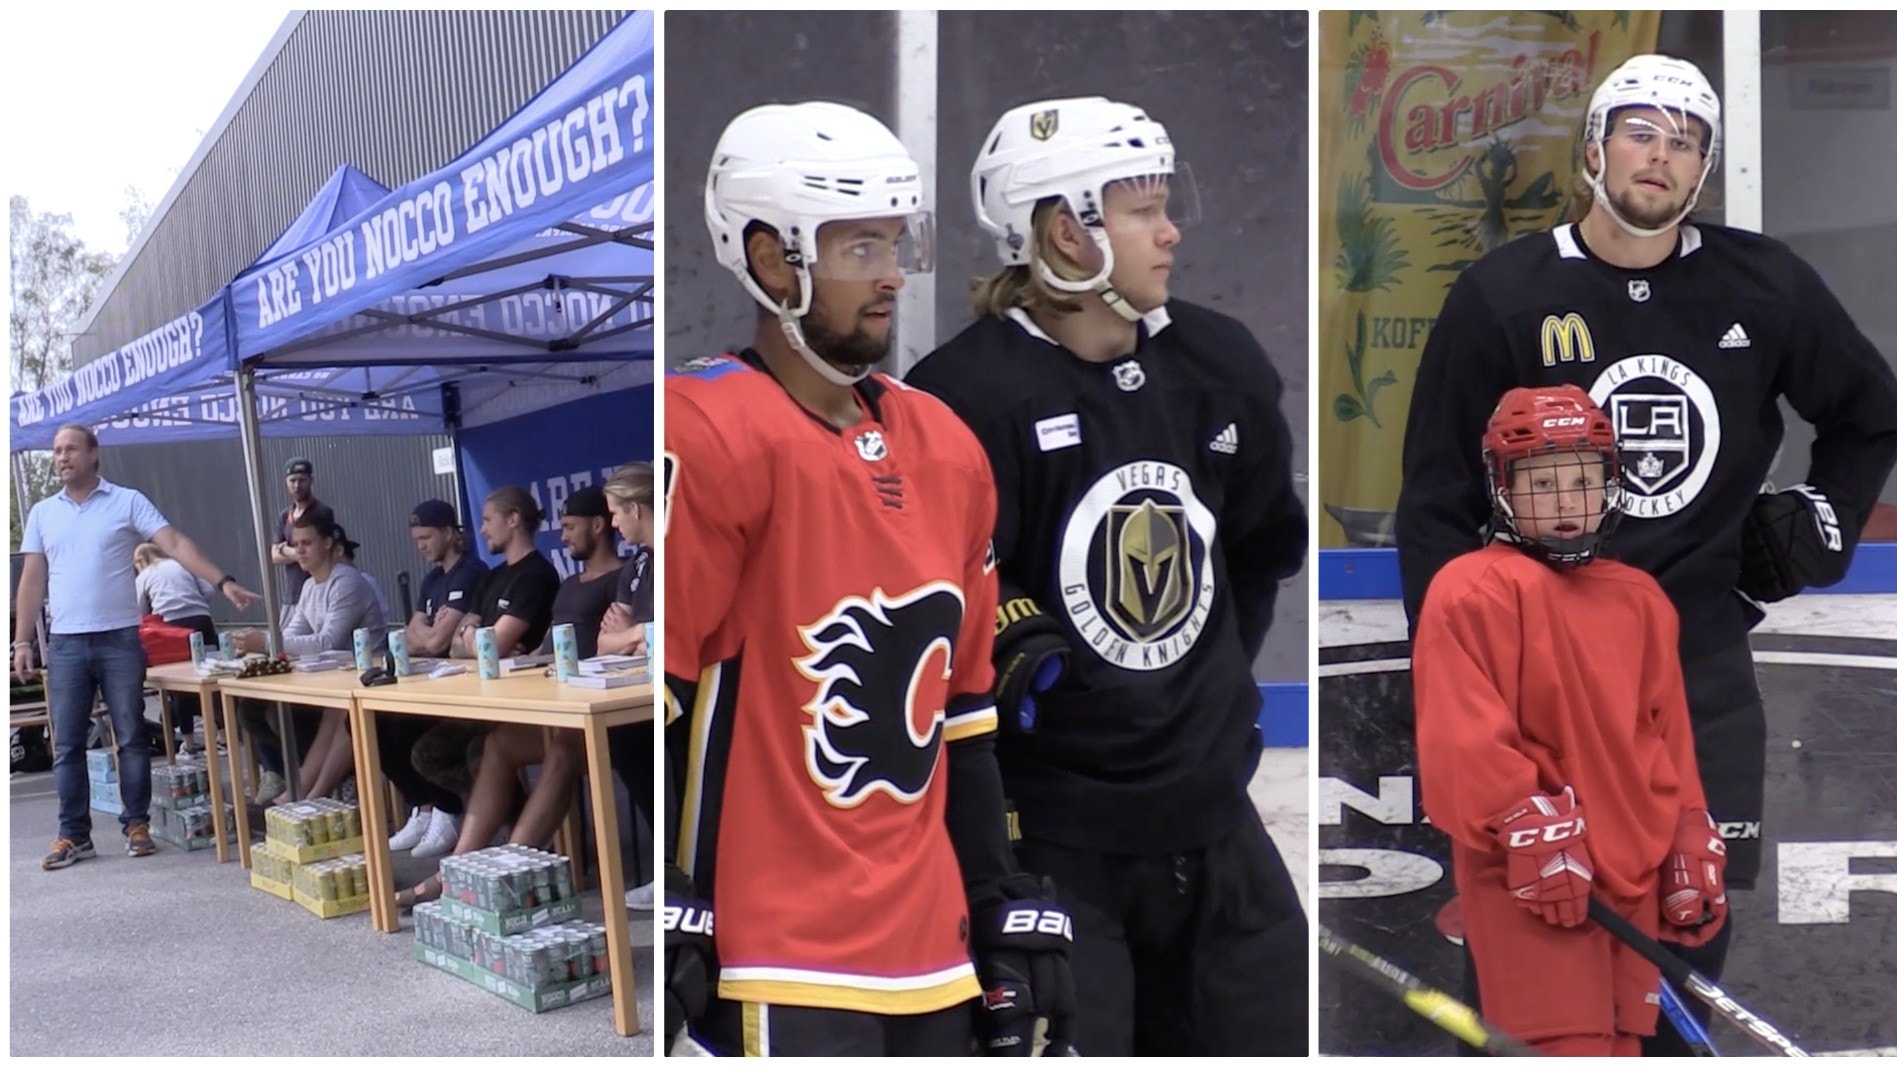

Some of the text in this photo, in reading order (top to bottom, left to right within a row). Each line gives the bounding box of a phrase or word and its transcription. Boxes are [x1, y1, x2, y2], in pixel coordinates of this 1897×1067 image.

[1653, 75, 1693, 87] CCM
[1378, 30, 1600, 190] Carnival
[257, 260, 302, 329] ARE
[302, 229, 356, 305] YOU
[360, 180, 455, 280] NOCCO
[460, 74, 649, 234] ENOUGH?
[18, 311, 204, 427] ARE YOU NOCCO ENOUGH?
[1607, 357, 1692, 386] LA KINGS
[1543, 417, 1586, 428] CCM
[1619, 405, 1682, 435] LA
[1116, 464, 1181, 490] VEGAS
[1624, 489, 1686, 515] OCKEY
[1065, 583, 1130, 664] GOLDEN
[1143, 583, 1213, 668] KNIGHTS
